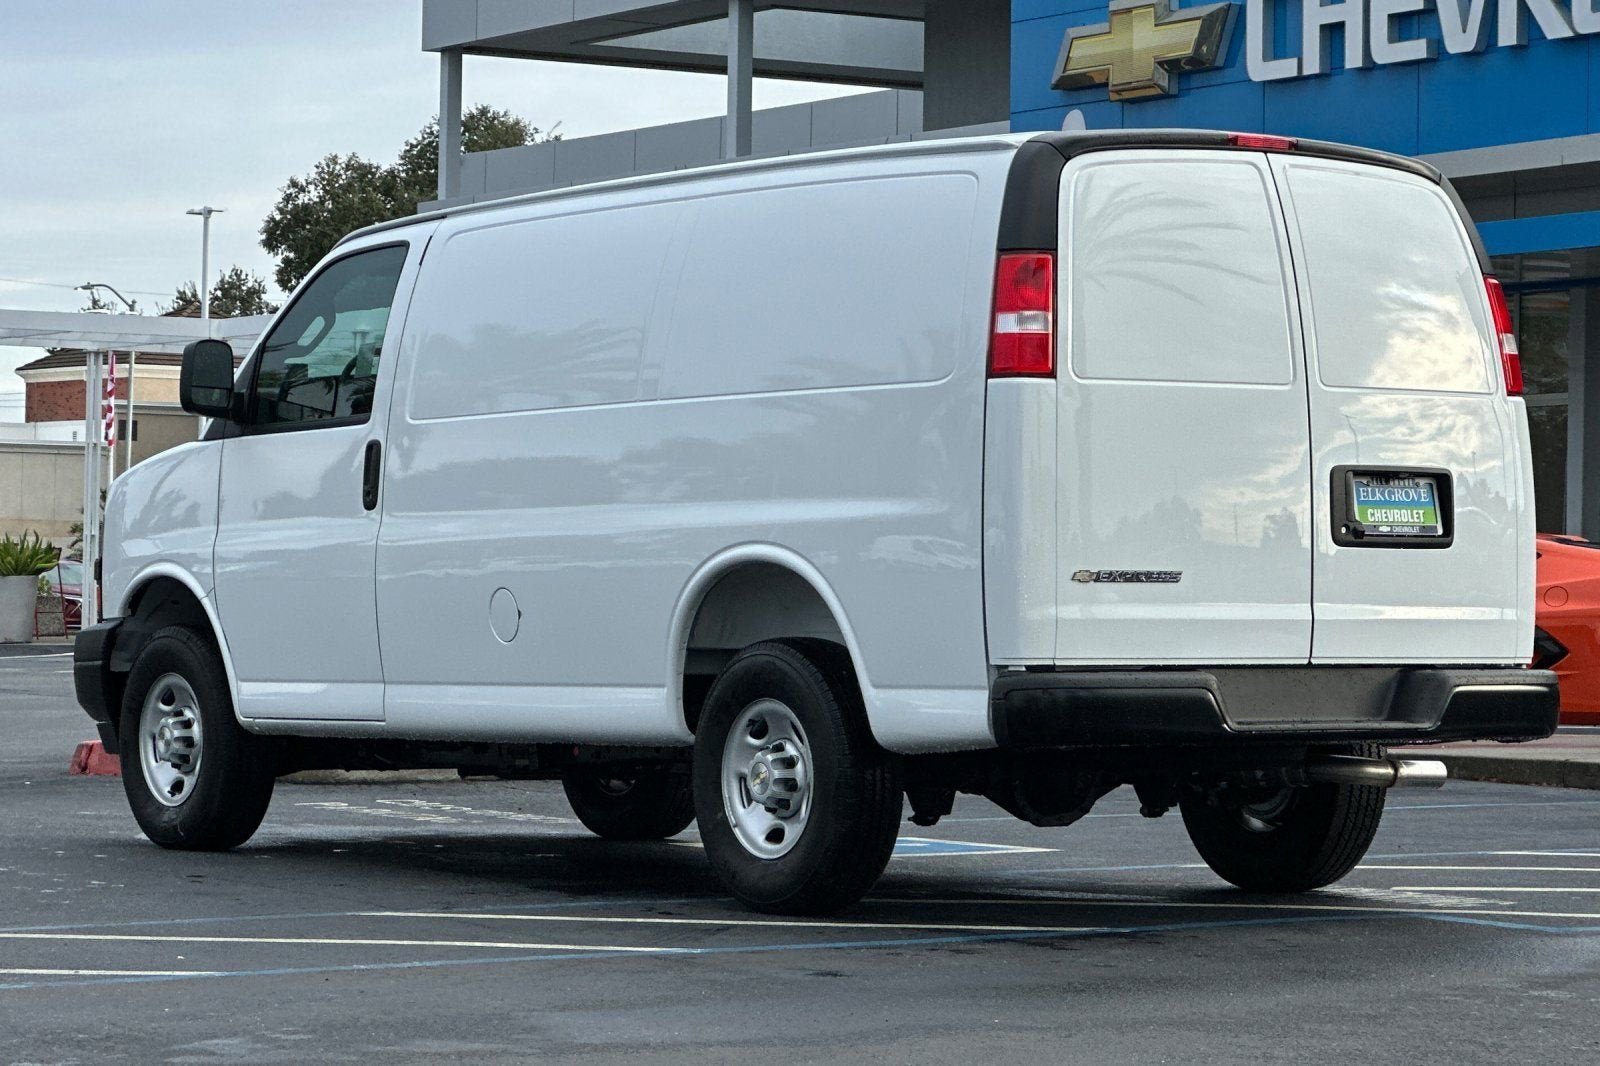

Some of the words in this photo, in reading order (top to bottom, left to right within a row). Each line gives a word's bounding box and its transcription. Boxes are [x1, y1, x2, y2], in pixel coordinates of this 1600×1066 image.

[1246, 0, 1600, 82] CHEV
[1359, 487, 1385, 501] ELK
[1385, 488, 1429, 502] GROVE
[1367, 508, 1425, 523] CHEVROLET
[1096, 570, 1183, 582] EXPRESS
